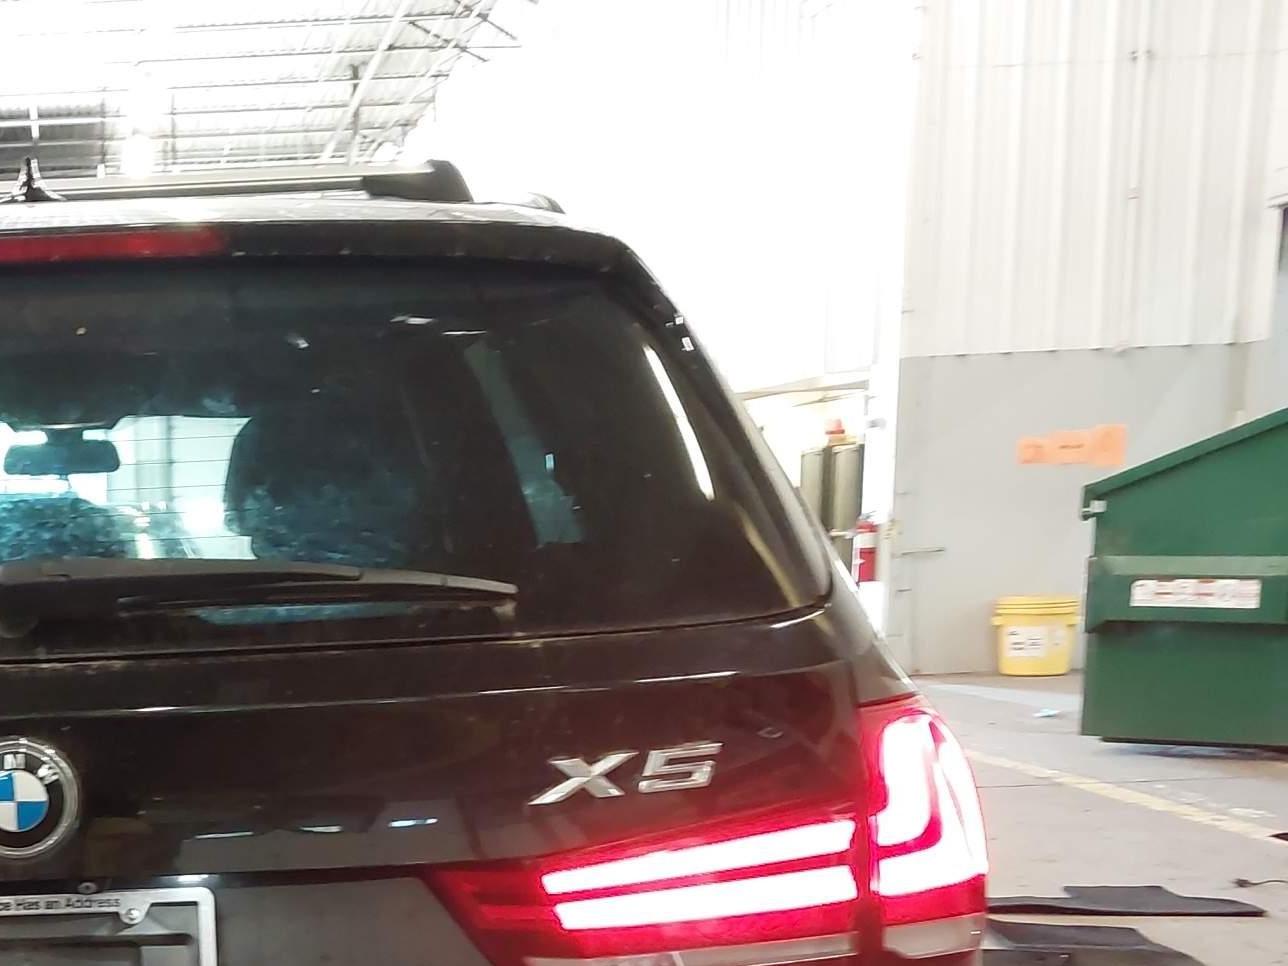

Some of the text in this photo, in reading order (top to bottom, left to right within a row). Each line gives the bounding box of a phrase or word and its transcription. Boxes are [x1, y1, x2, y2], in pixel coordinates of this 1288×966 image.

[527, 741, 724, 805] X5
[16, 899, 40, 911] Has
[45, 900, 60, 909] an
[66, 897, 121, 908] Address
